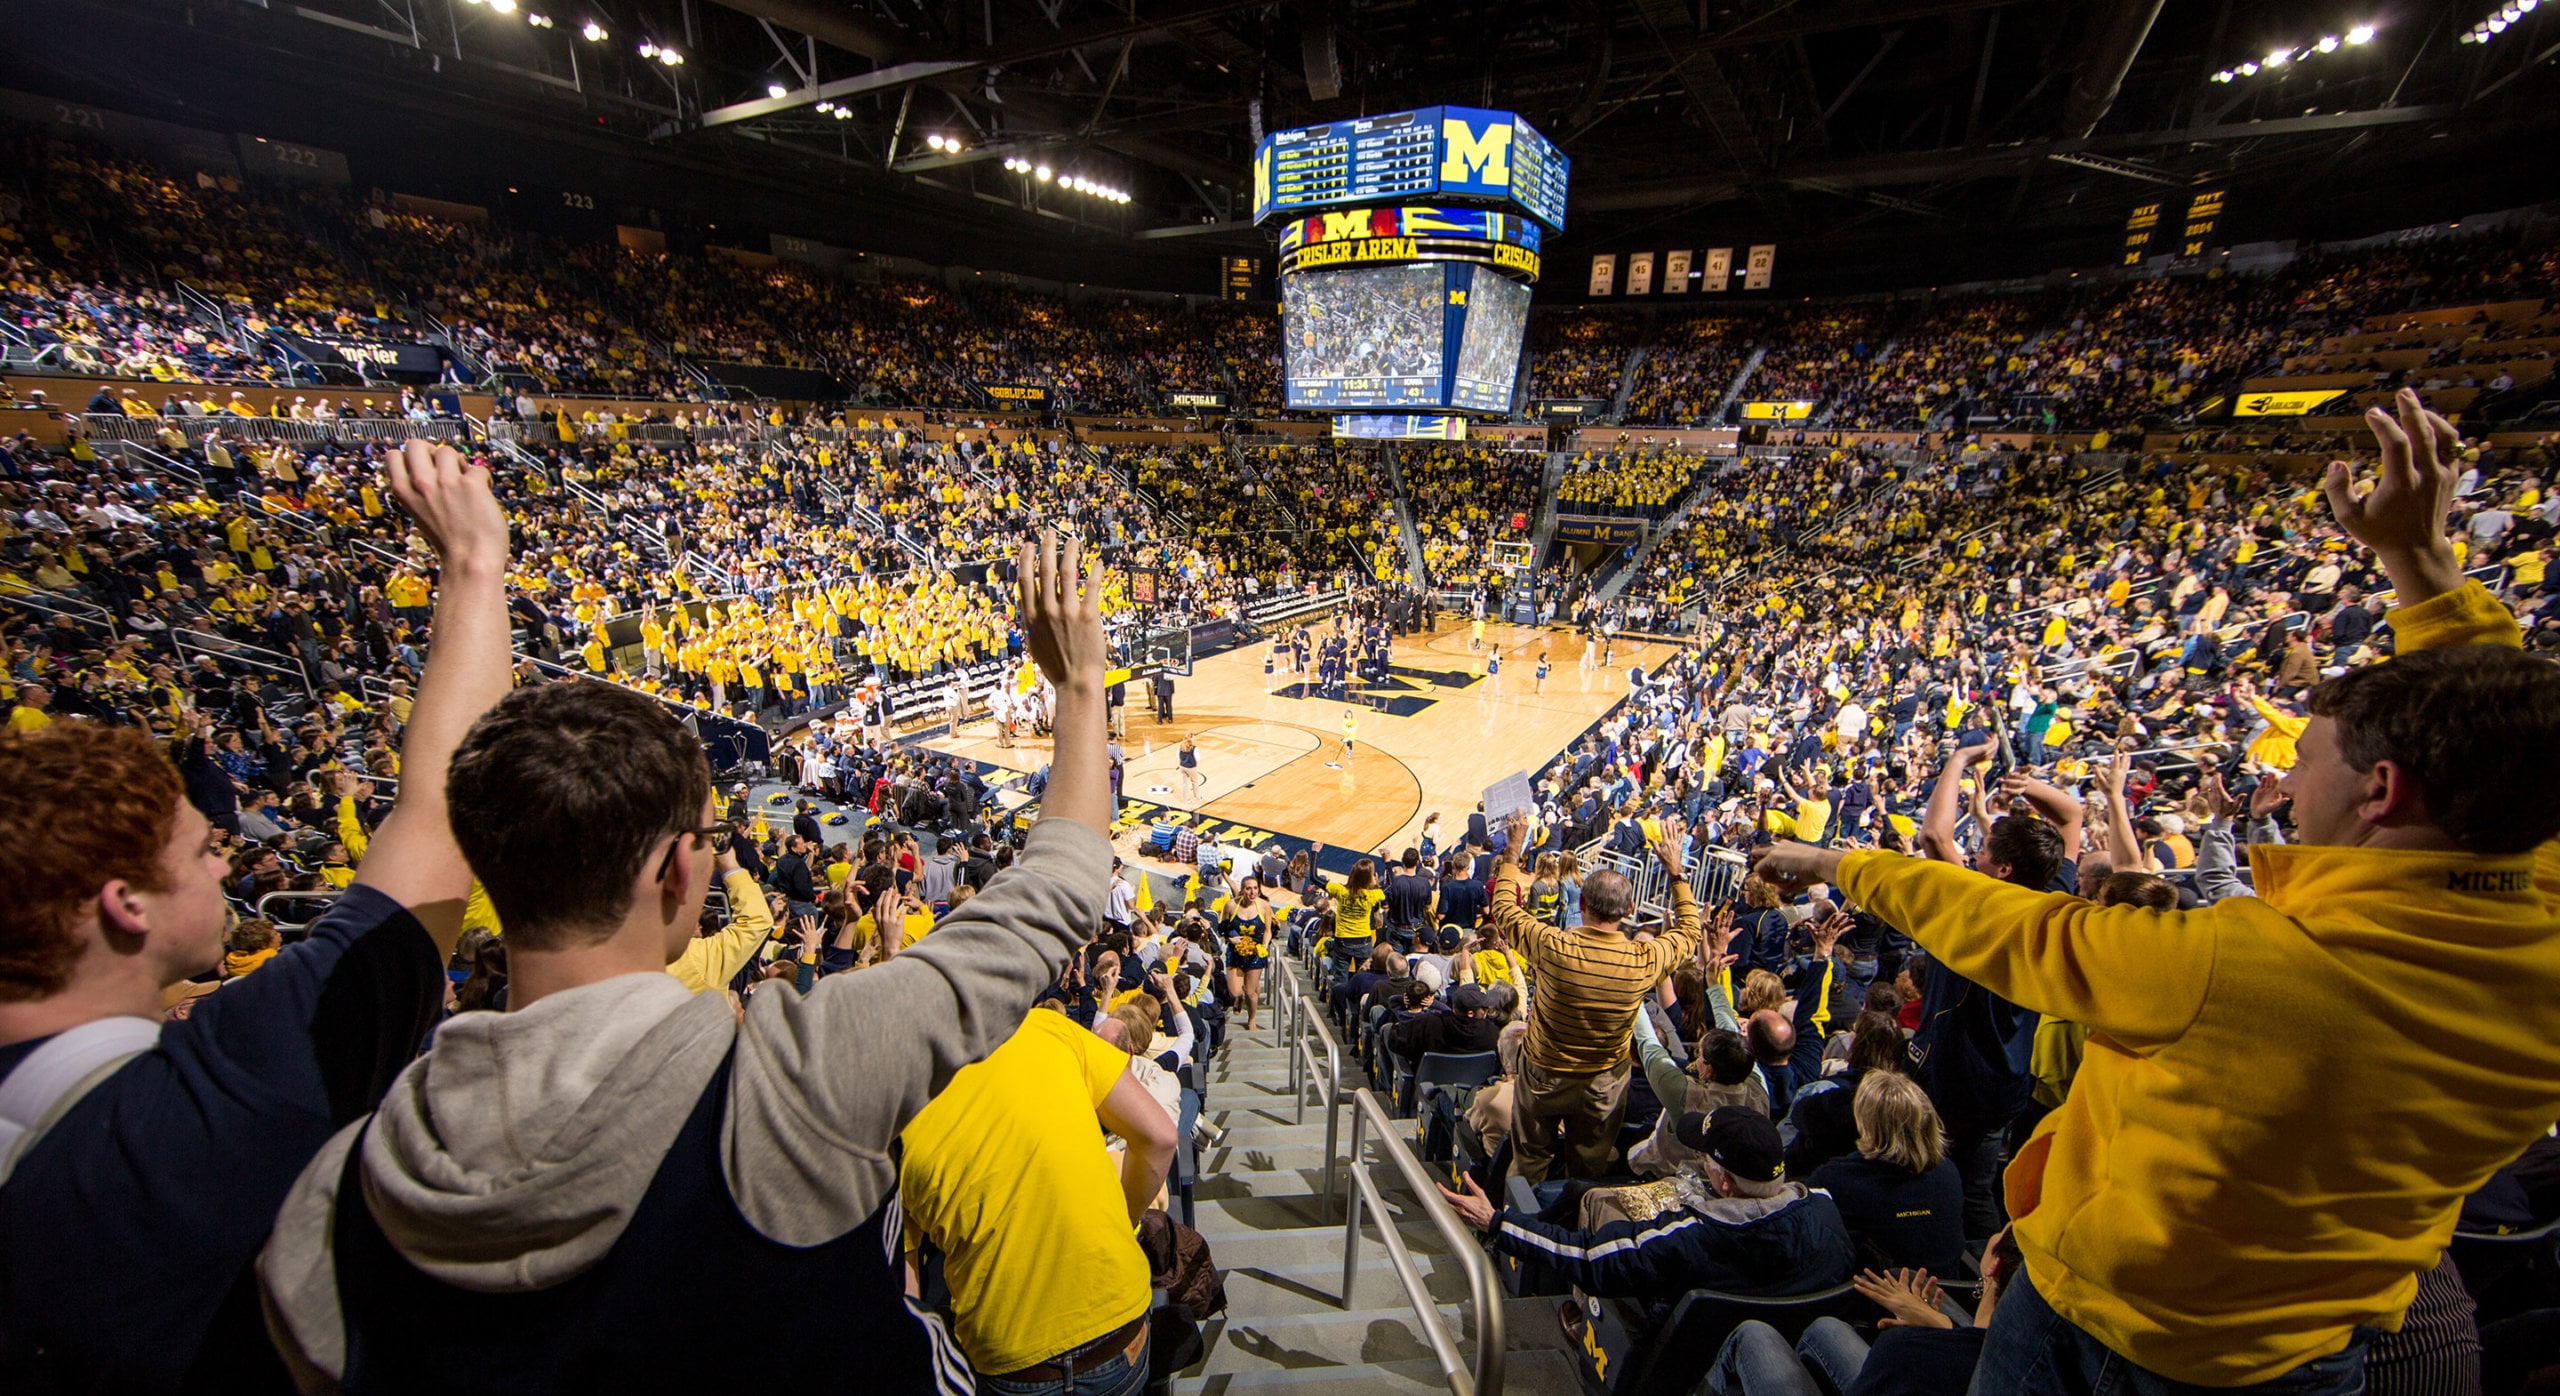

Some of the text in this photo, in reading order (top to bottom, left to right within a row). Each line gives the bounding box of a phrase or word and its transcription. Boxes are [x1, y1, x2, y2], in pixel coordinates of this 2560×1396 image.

[1441, 119, 1512, 186] M
[562, 192, 594, 210] 223
[1322, 208, 1372, 242] M
[1297, 237, 1419, 268] CRISLER ARENA
[1449, 290, 1466, 305] M
[1343, 379, 1369, 390] 11:34
[1173, 394, 1217, 406] MICHIGAN
[1408, 388, 1420, 397] 43
[1771, 405, 1788, 417] M
[1561, 525, 1637, 540] ALUMNI M BAND
[1895, 1209, 1933, 1219] MICHIGAN
